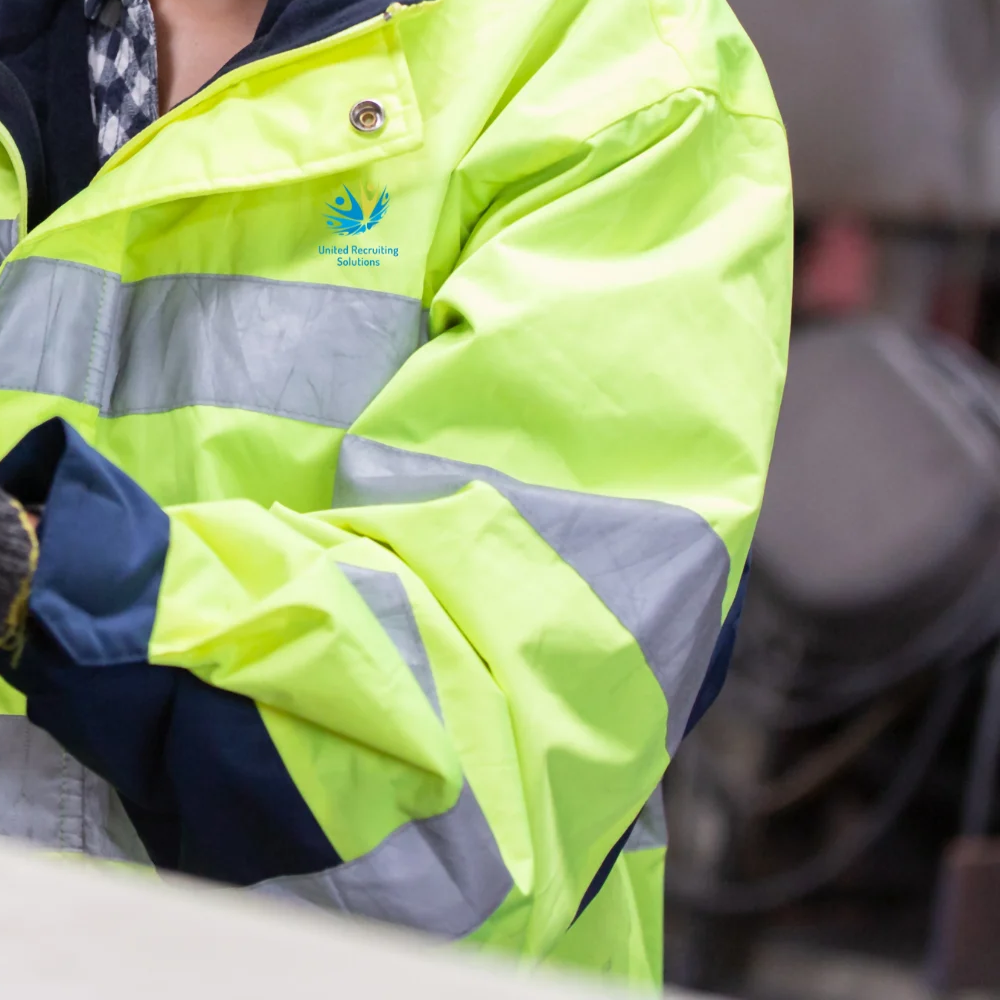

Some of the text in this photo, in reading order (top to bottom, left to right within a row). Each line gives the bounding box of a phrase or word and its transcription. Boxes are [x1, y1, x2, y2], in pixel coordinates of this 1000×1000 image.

[318, 245, 399, 257] United Recruiting
[337, 257, 380, 267] Solutions
